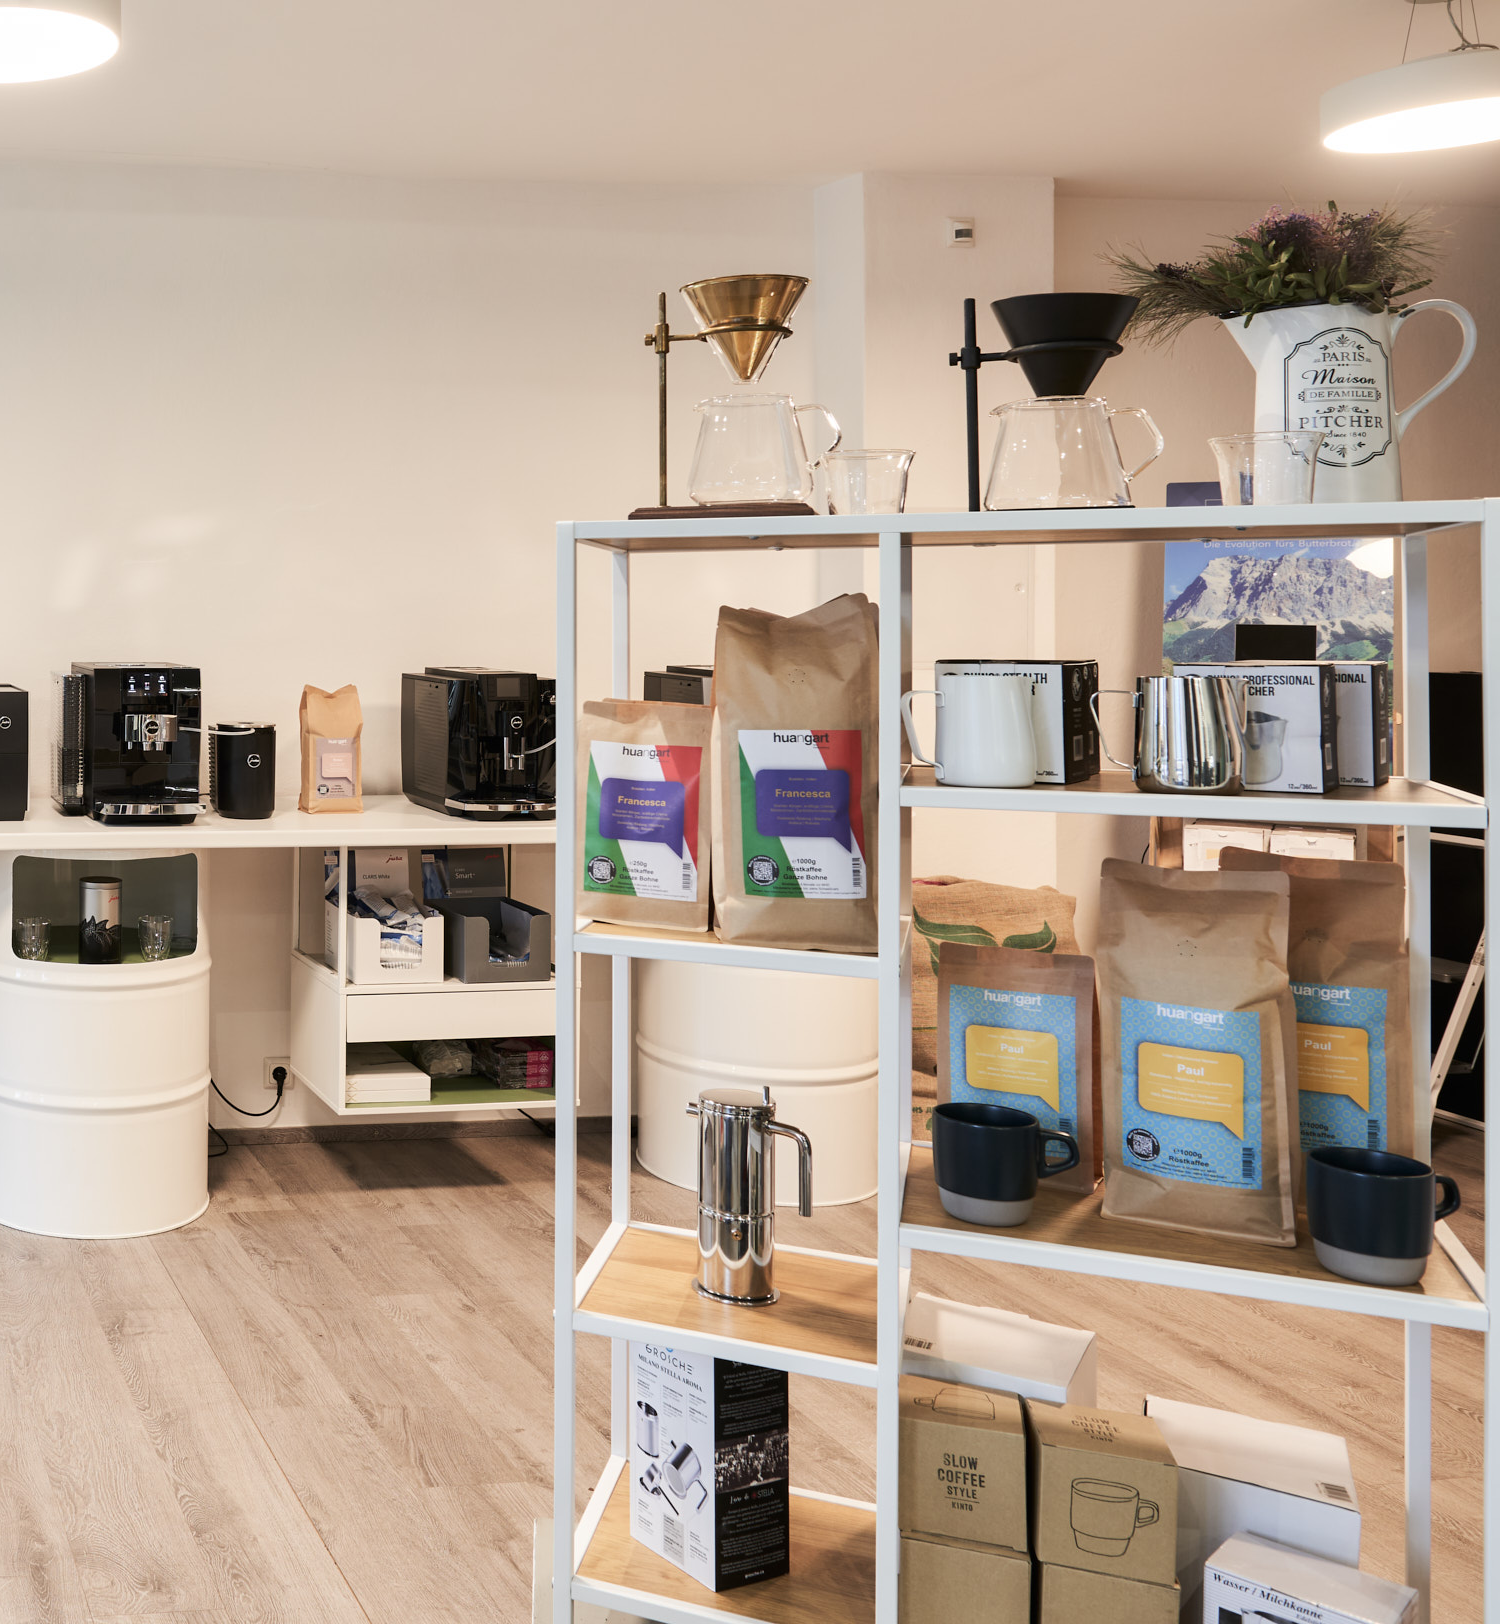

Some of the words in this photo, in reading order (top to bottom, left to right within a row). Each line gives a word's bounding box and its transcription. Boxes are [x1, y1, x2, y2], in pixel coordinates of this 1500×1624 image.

[1322, 352, 1365, 362] PARIS
[1301, 368, 1376, 385] Maison
[1327, 390, 1374, 398] FAMILLE
[1298, 415, 1384, 429] PITCHER
[1203, 540, 1221, 548] Die
[1225, 540, 1271, 548] Evolution
[773, 732, 830, 745] huangart
[622, 746, 670, 760] huangart
[775, 788, 831, 798] Francesca
[617, 795, 666, 807] Francesca
[639, 875, 659, 883] Bohne
[984, 989, 1042, 1007] huangart
[1156, 1003, 1224, 1025] huangart
[1000, 1043, 1024, 1054] Paul
[1304, 1039, 1332, 1051] Paul
[1177, 1063, 1205, 1077] Paul
[1300, 1130, 1336, 1140] östkaffee
[645, 1343, 694, 1375] GROSCHE
[638, 1353, 660, 1371] MILANO
[660, 1364, 682, 1382] STELLA
[681, 1376, 703, 1393] AROMA
[1071, 1419, 1122, 1434] COFFEE
[1074, 1414, 1110, 1426] SLOW
[1083, 1427, 1115, 1438] STYLE
[1090, 1435, 1114, 1443] KINTO
[943, 1452, 979, 1471] SLOW
[937, 1468, 986, 1489] COFFEE
[947, 1485, 978, 1499] STYLE
[951, 1501, 974, 1512] KINTO
[1213, 1572, 1251, 1593] Wasser
[1259, 1589, 1324, 1620] Milchkanne
